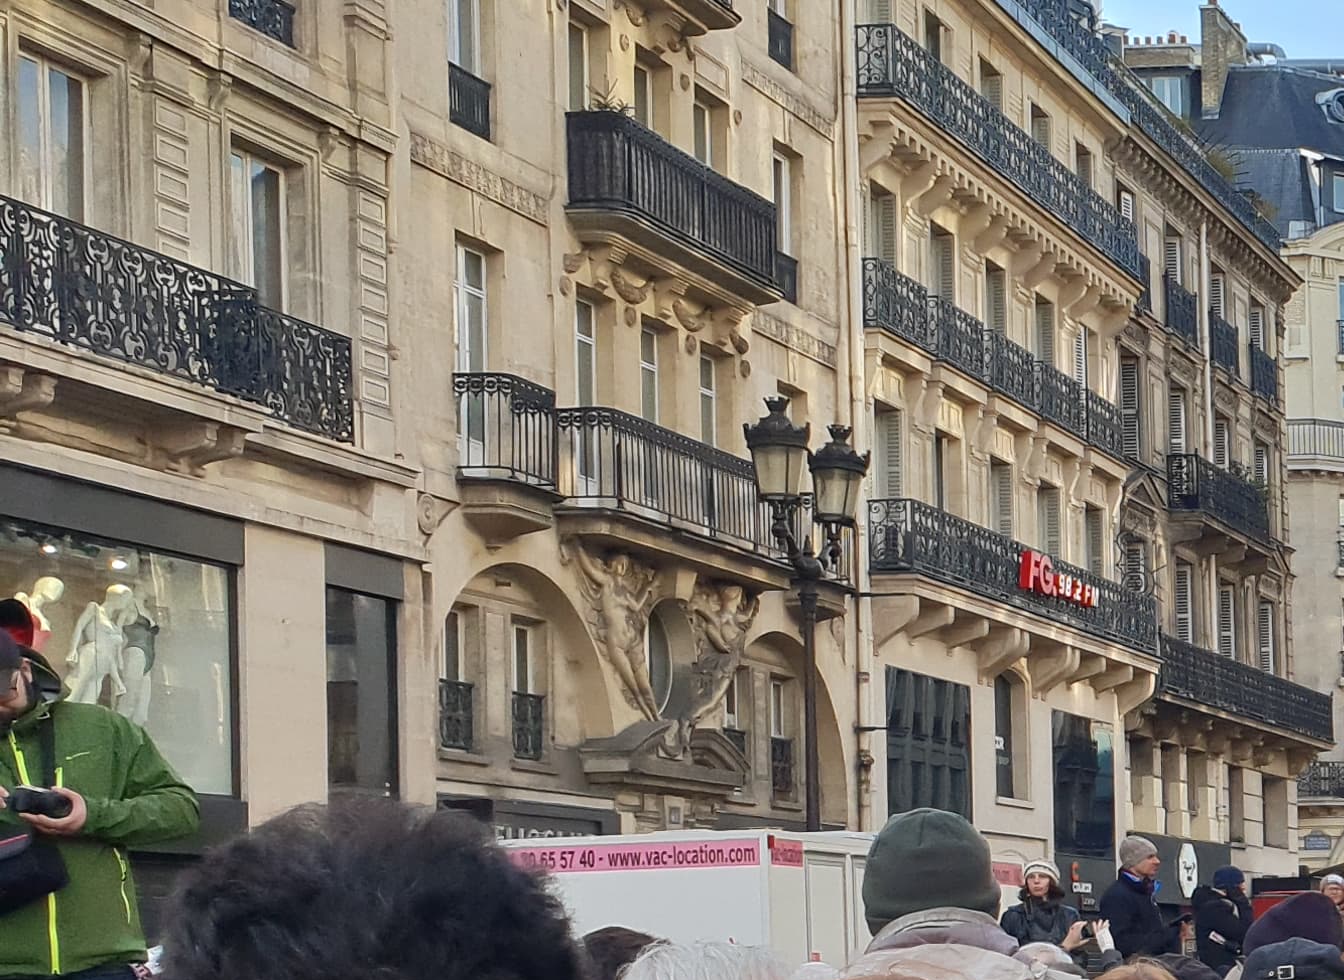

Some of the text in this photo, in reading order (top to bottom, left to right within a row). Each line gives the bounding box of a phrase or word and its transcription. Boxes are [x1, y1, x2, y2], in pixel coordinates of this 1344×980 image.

[560, 851, 575, 868] 57
[579, 850, 595, 868] 40
[608, 844, 756, 867] www.vac-location.com
